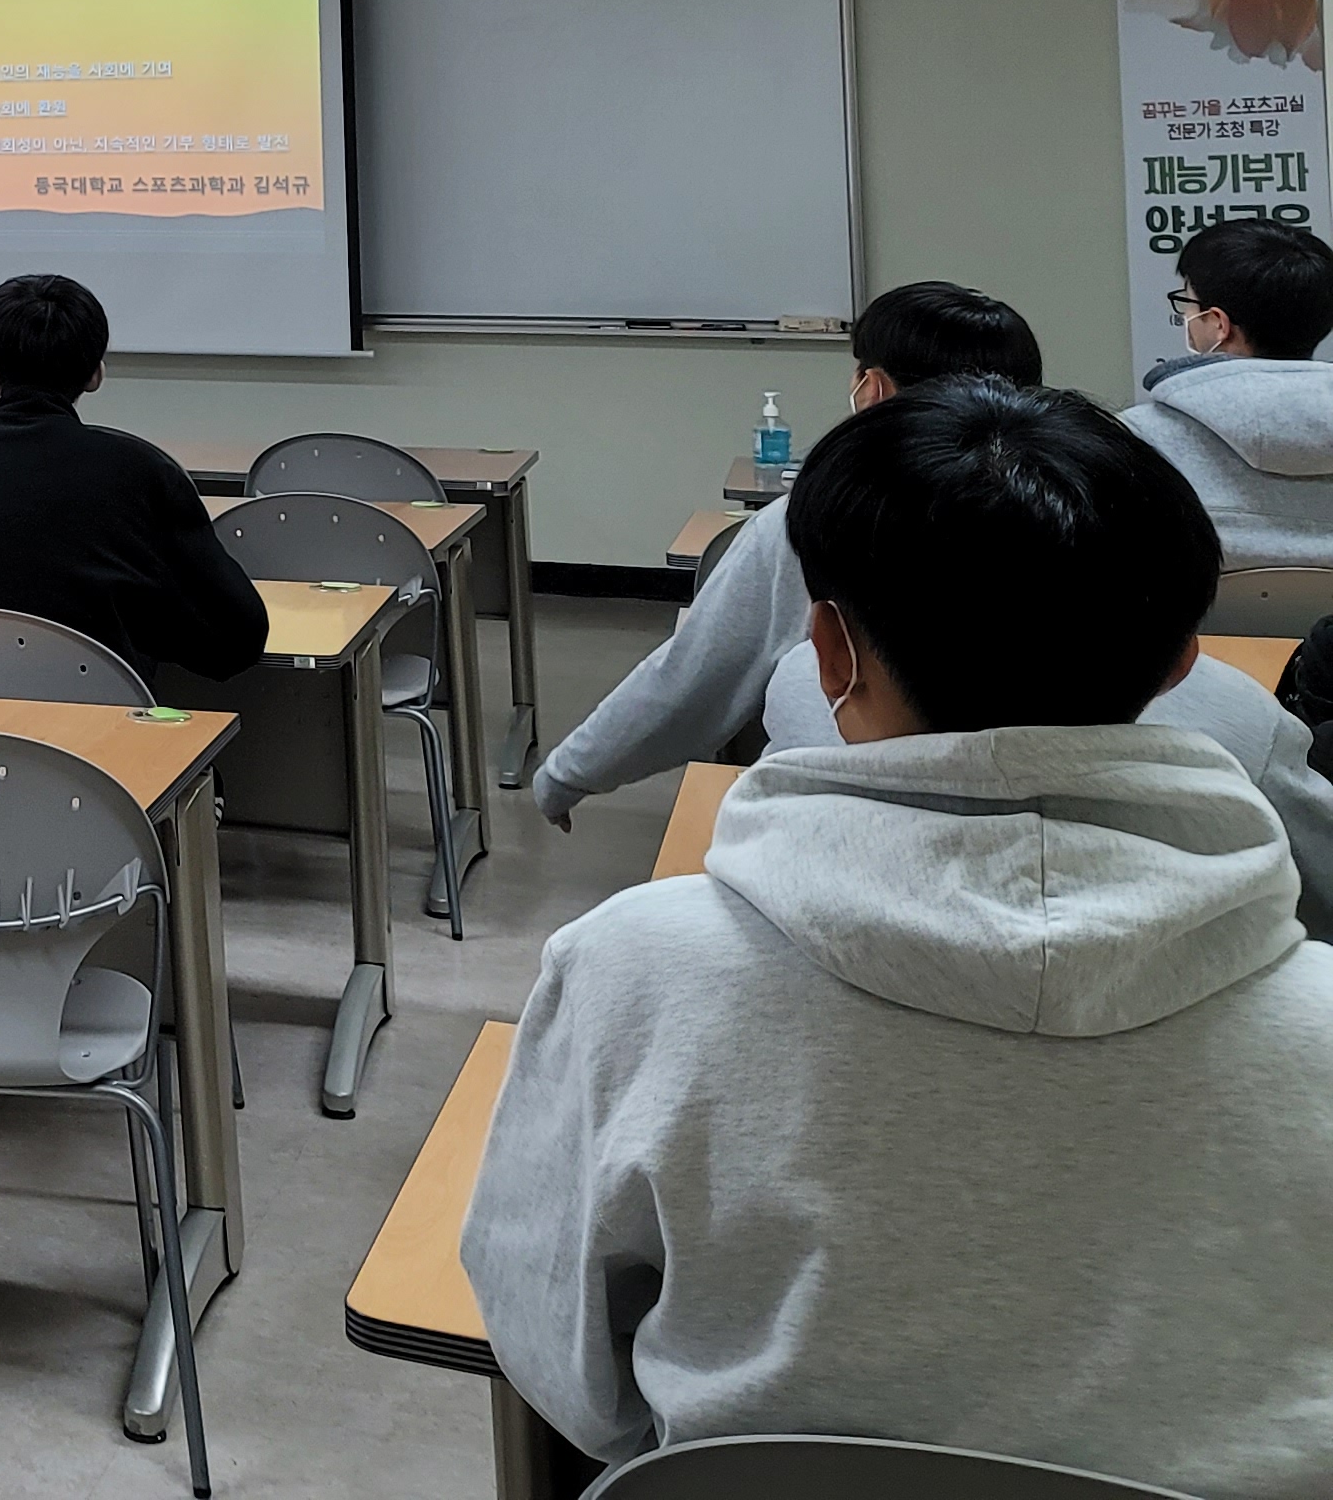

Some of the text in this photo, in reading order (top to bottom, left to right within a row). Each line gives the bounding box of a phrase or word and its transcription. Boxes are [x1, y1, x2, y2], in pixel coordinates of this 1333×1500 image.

[1142, 94, 1305, 119] 꿈꾸는 가을 스포츠교실
[1167, 119, 1281, 141] 전문가 초청 특강
[34, 174, 310, 195] 동국대학교 스포츠과학과 김석규
[1142, 152, 1309, 195] 재능기부자
